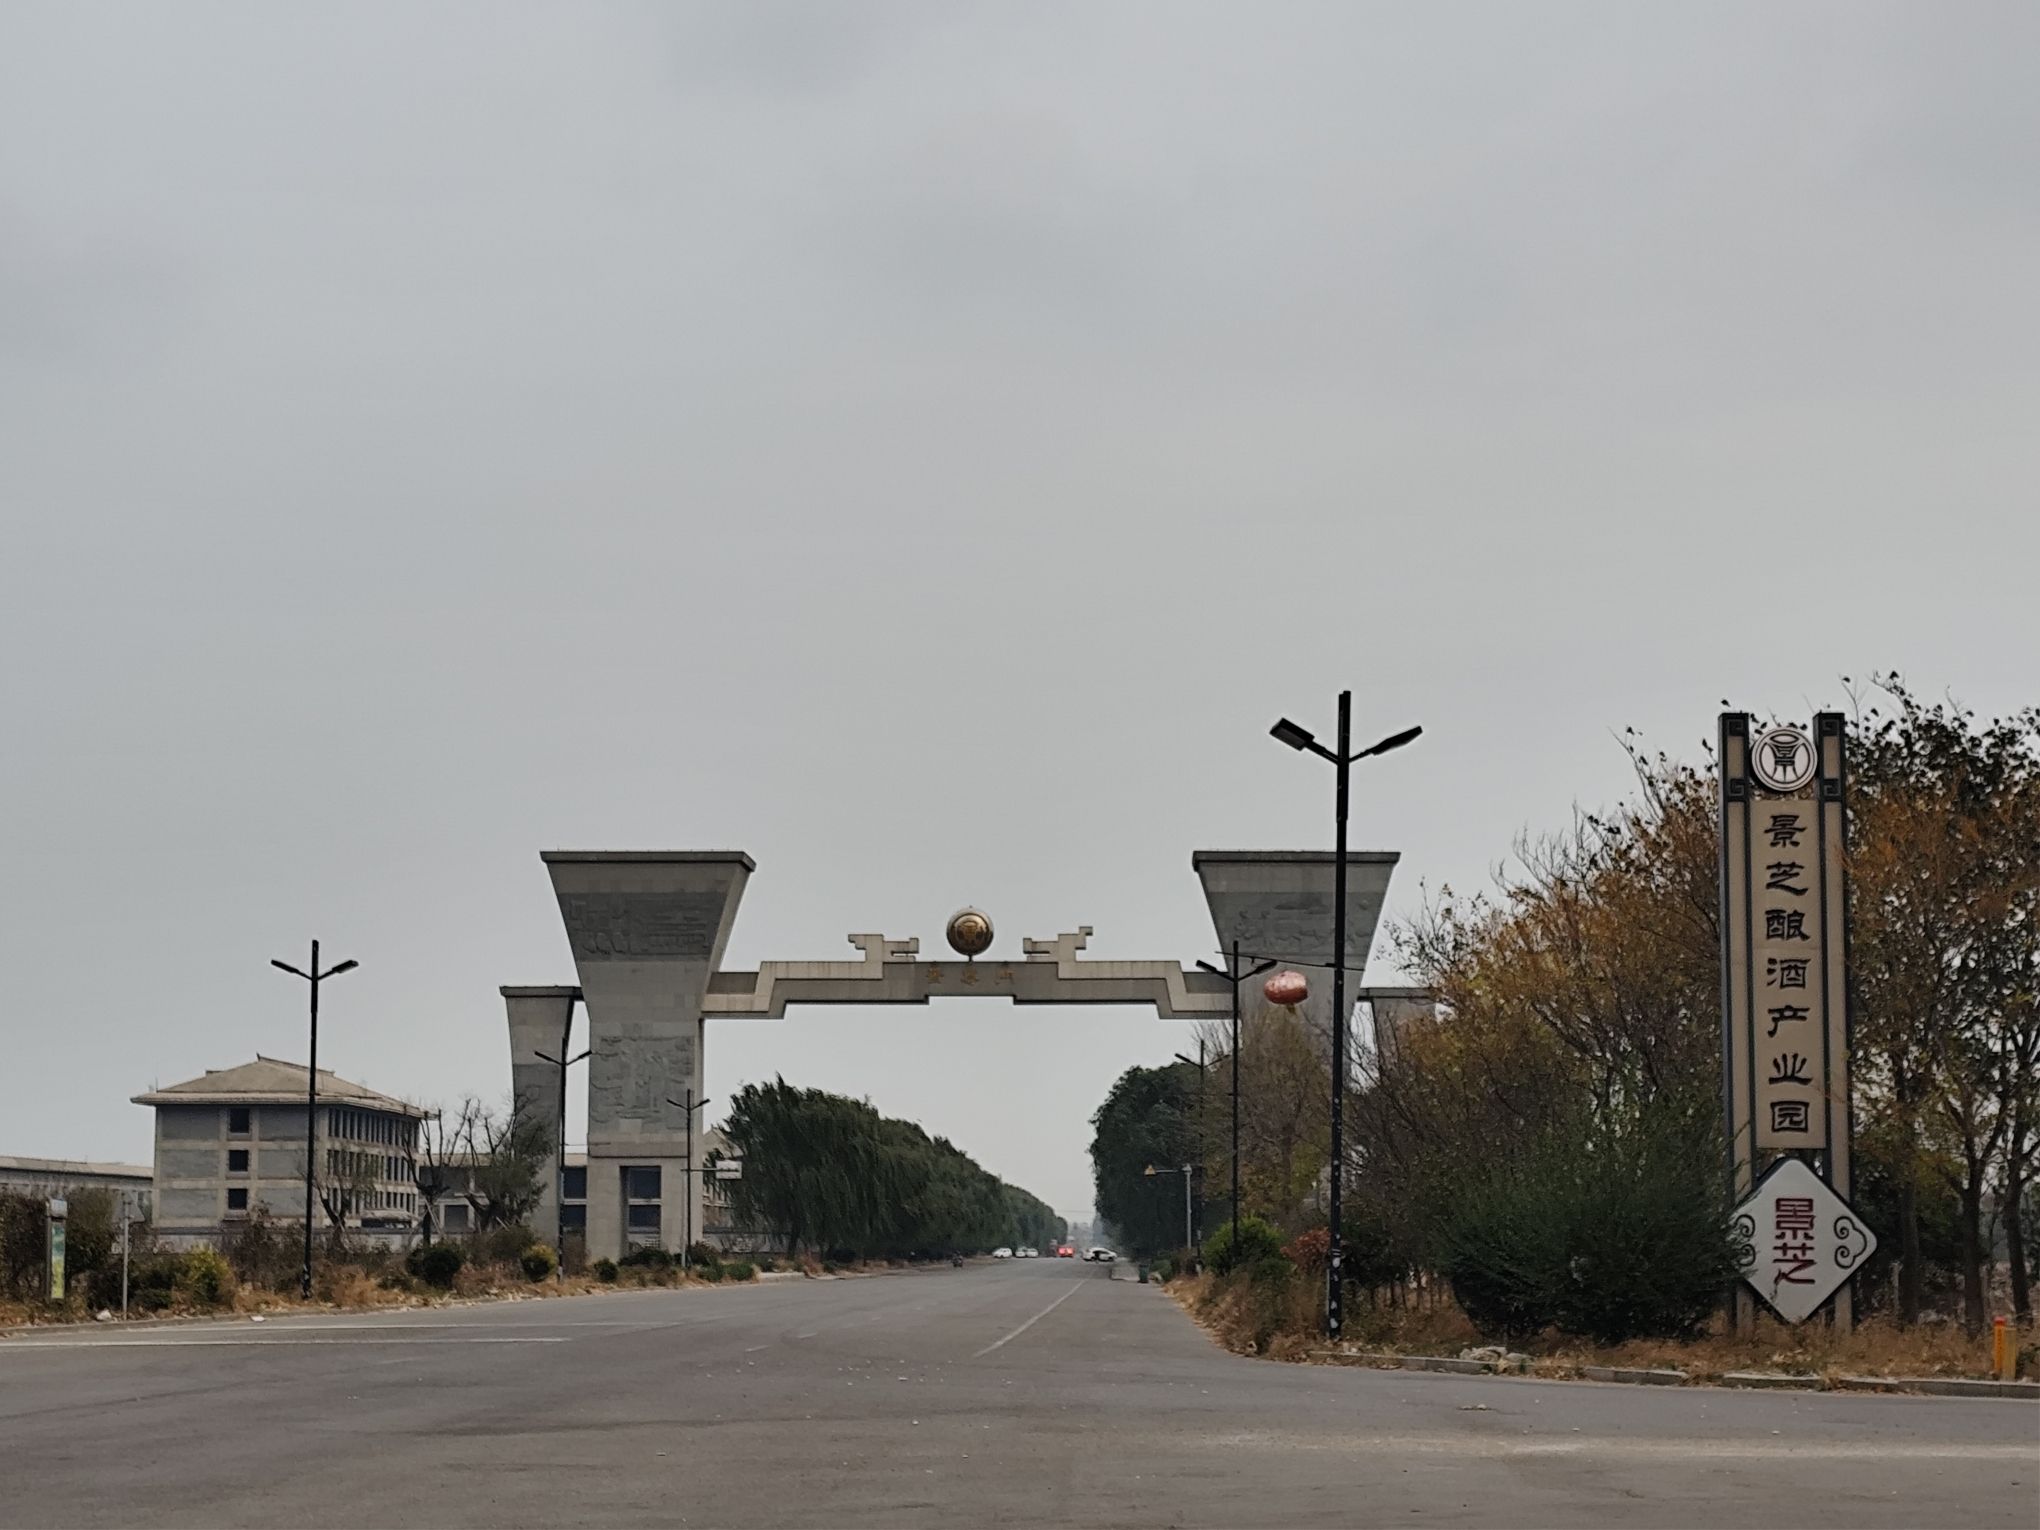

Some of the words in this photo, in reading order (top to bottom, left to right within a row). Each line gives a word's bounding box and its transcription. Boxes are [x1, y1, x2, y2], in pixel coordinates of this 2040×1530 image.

[1764, 814, 1813, 1133] 景芝酿酒产业园
[1773, 1198, 1816, 1284] 景芝
